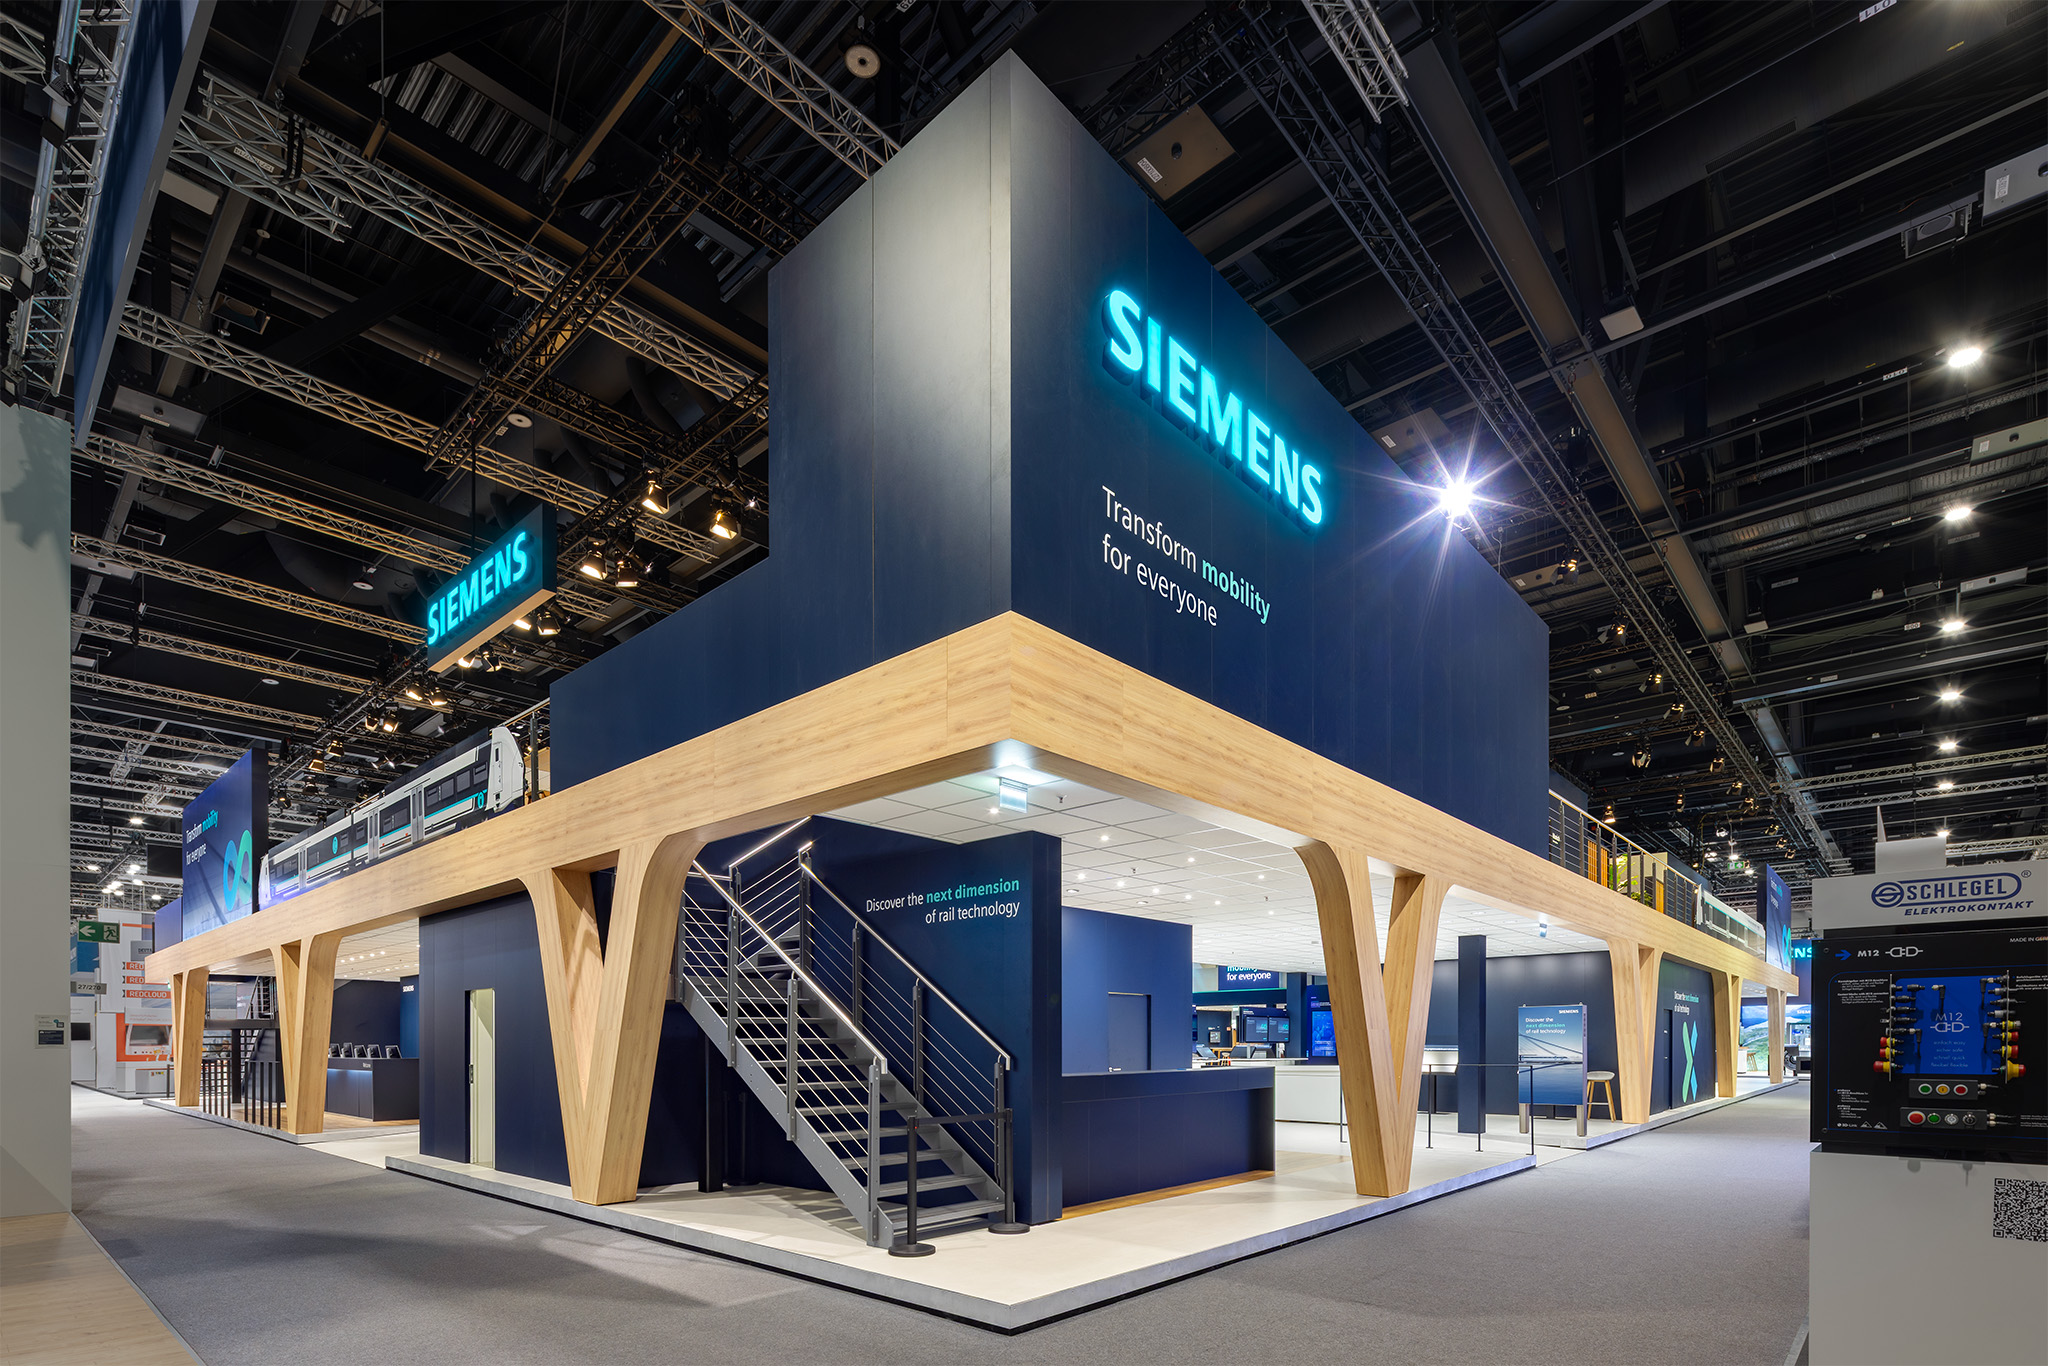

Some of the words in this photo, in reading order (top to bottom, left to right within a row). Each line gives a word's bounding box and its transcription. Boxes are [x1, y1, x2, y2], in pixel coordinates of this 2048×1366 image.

[1107, 289, 1323, 526] SIEMENS
[1102, 485, 1197, 573] Transform
[1202, 559, 1271, 624] mobility
[428, 531, 528, 645] SIEMENS
[1102, 534, 1131, 575] for
[1136, 562, 1218, 626] everyone
[866, 897, 906, 912] Discover
[907, 892, 924, 907] the
[926, 888, 953, 904] next
[955, 878, 1020, 900] dimension
[1907, 878, 2007, 900] SCHLEGEL
[926, 908, 936, 924] of
[938, 906, 955, 922] rail
[957, 900, 1020, 920] technology
[1904, 900, 2034, 916] ELEKTROKONTAKT
[1857, 949, 1880, 958] M12
[1238, 972, 1272, 982] everyone
[129, 990, 168, 998] REDCLOUD
[1935, 1012, 1963, 1021] M12
